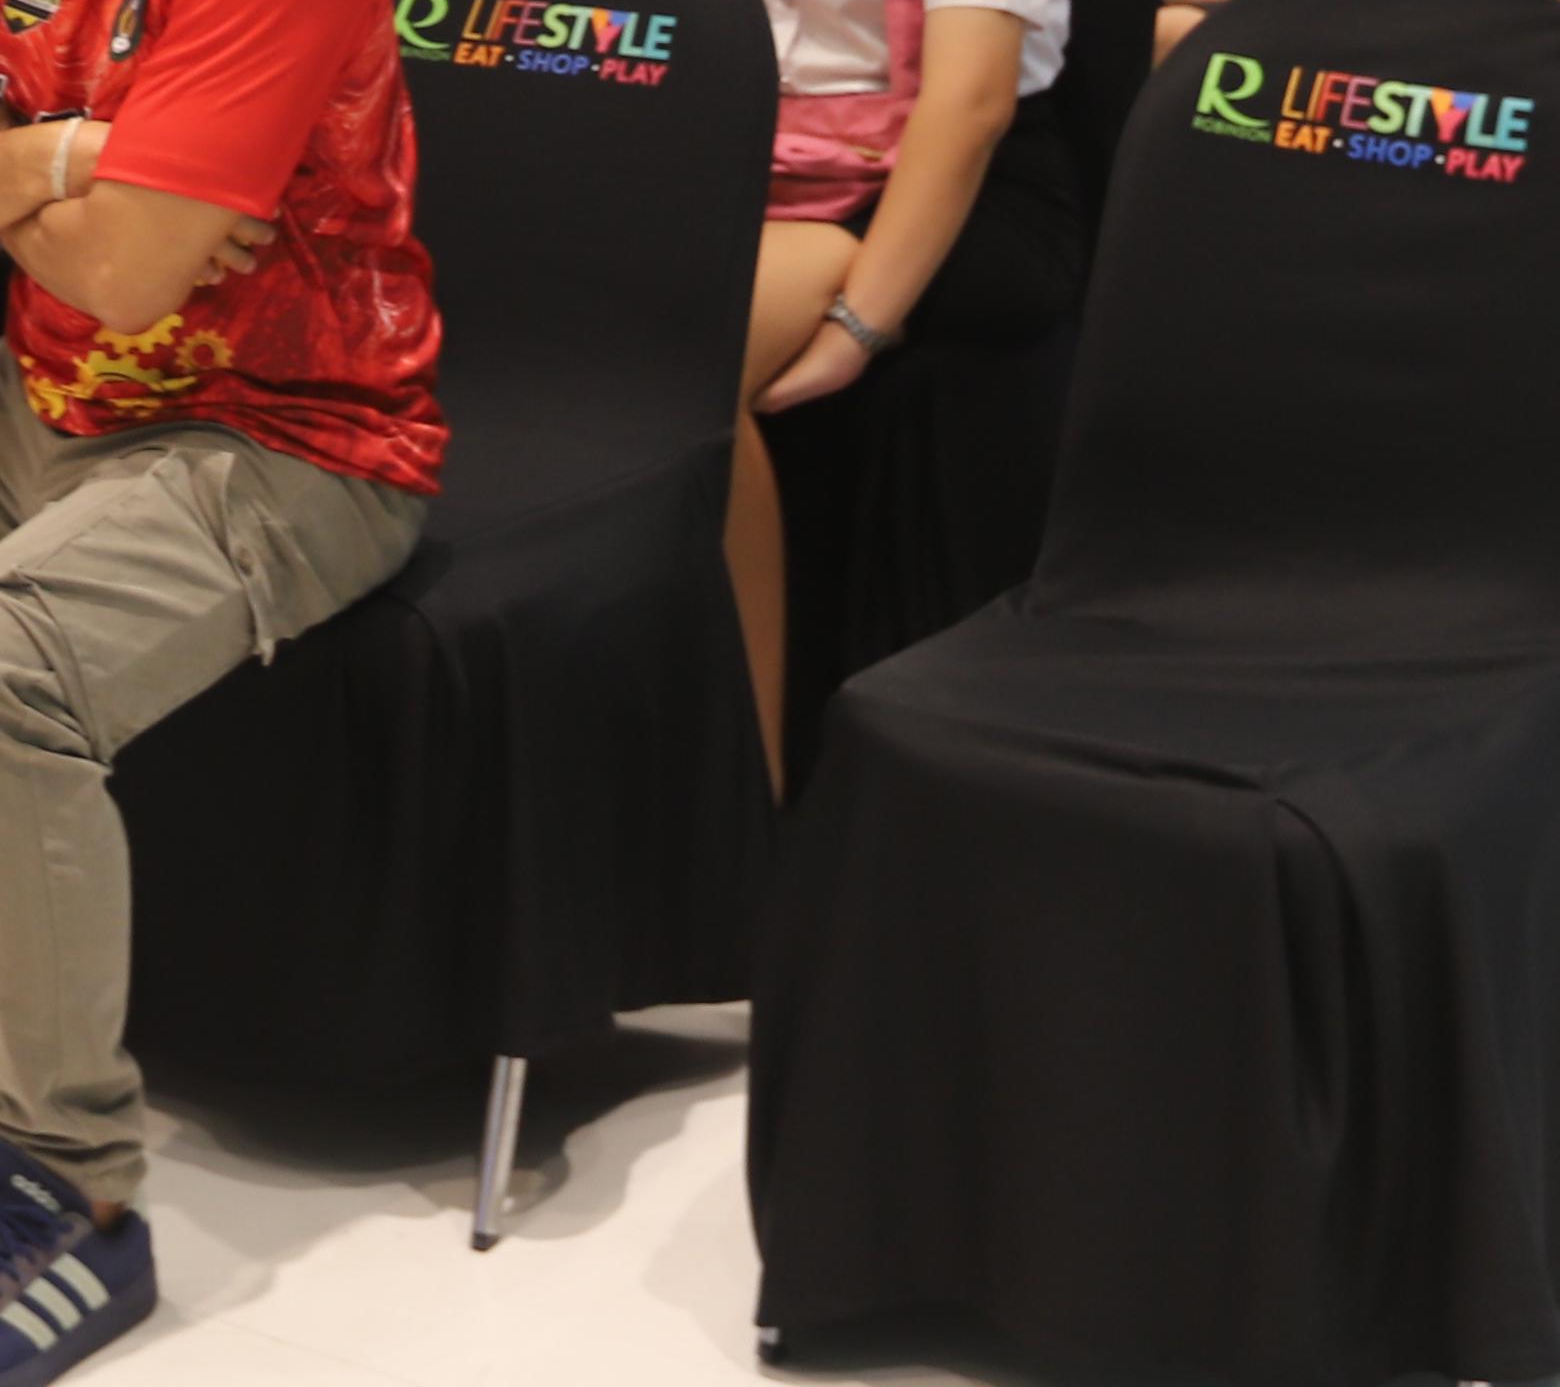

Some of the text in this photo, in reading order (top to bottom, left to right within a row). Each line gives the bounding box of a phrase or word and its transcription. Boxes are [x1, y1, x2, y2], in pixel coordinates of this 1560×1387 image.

[453, 42, 671, 87] EAT SHOP PLAY
[1195, 52, 1535, 152] R LIFESTYLE
[1274, 120, 1527, 183] EAT SHOP PLAY
